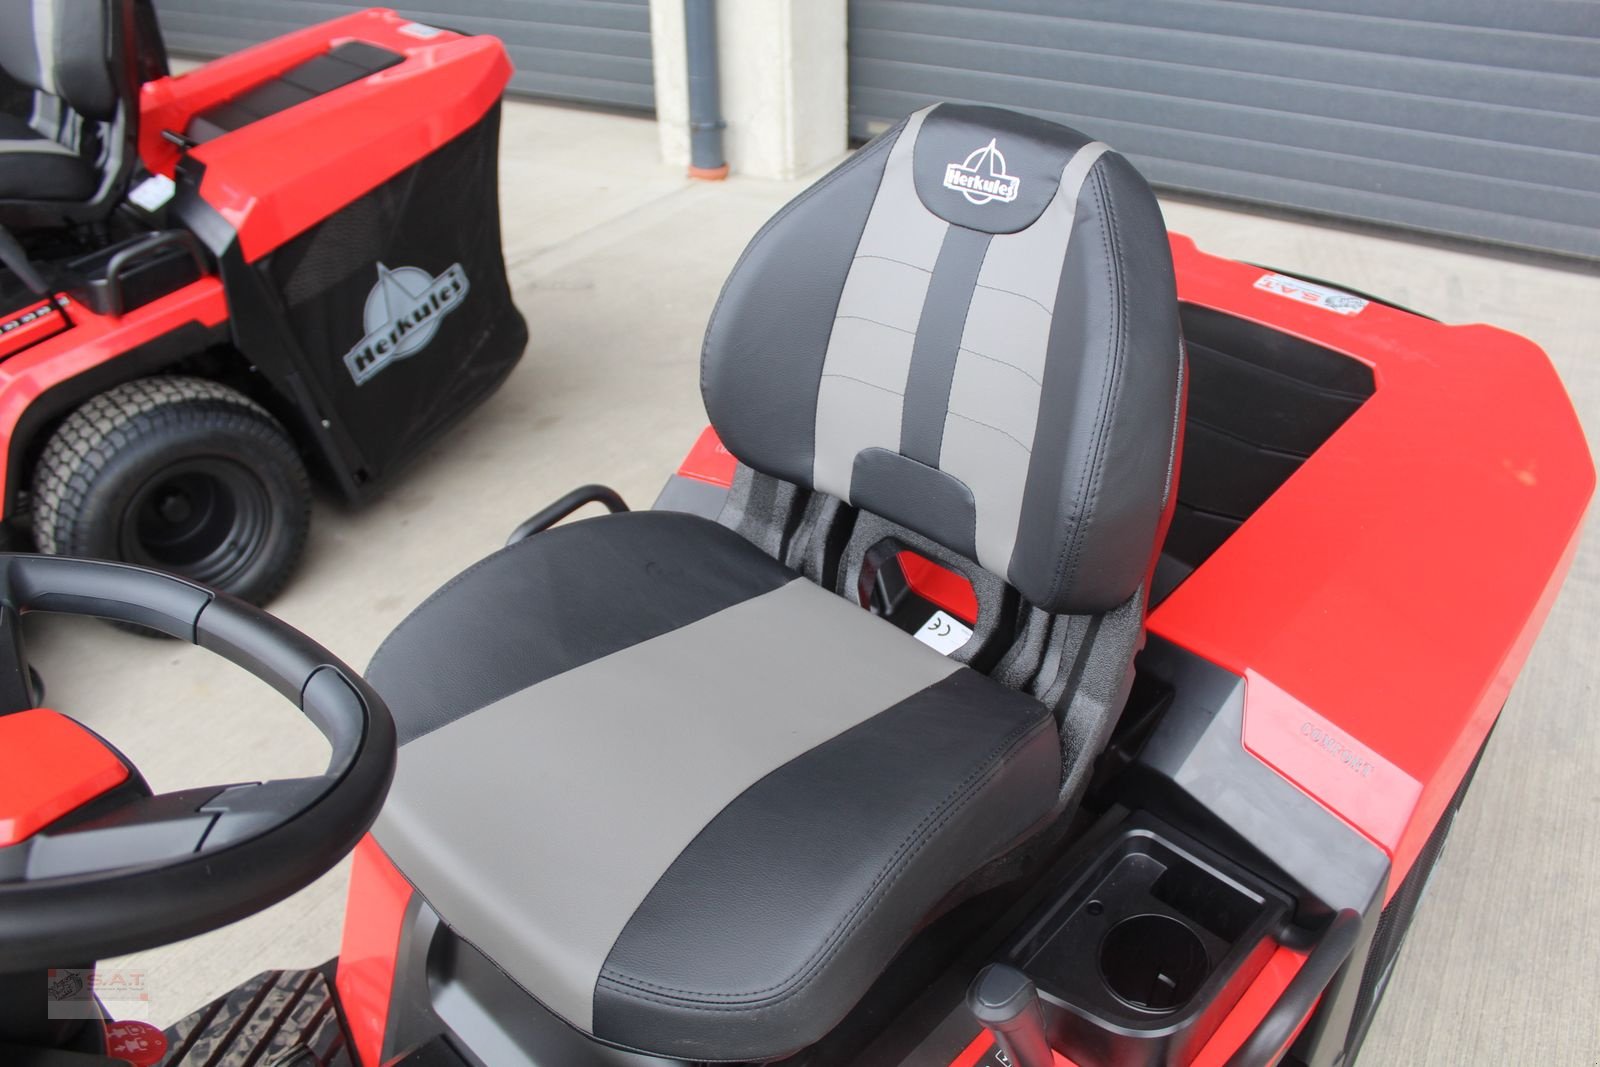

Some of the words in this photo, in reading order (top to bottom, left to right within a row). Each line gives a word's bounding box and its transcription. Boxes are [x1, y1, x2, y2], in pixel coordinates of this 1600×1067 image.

[947, 168, 1017, 199] Herkules
[354, 270, 462, 373] Herkules
[1300, 721, 1375, 778] COMFORT
